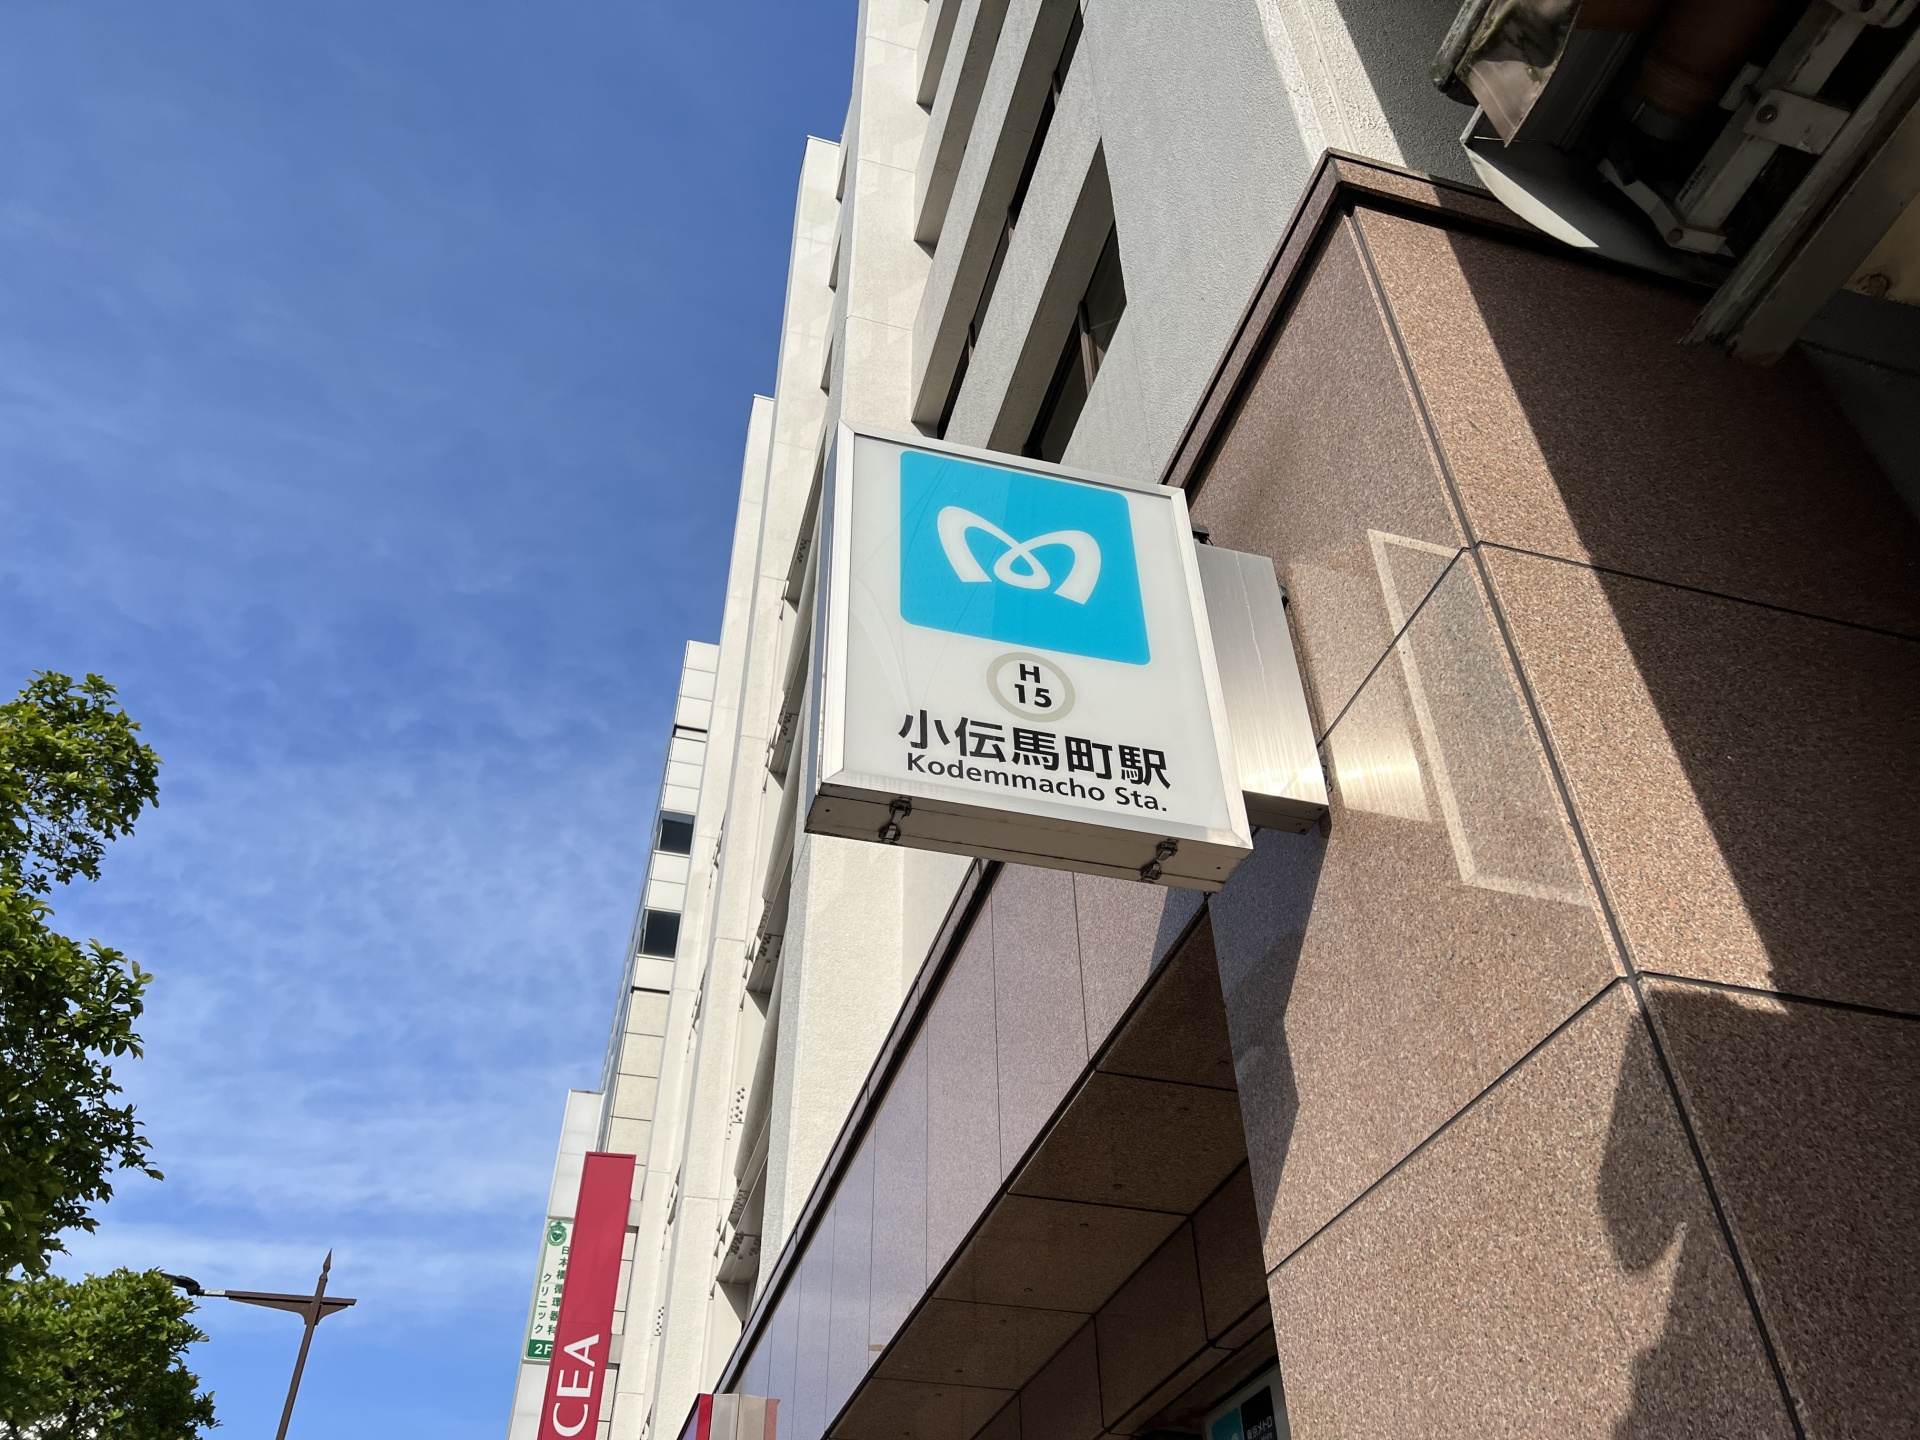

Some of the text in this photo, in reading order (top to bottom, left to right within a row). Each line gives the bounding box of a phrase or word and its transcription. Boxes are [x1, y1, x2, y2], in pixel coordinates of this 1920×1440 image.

[1018, 663, 1041, 684] H
[1014, 683, 1053, 708] 15
[898, 709, 1171, 789] 小伝馬町駅
[907, 752, 1168, 812] Kodemmacho Sta.
[534, 1272, 552, 1334] クリニック
[534, 1343, 553, 1355] 2F
